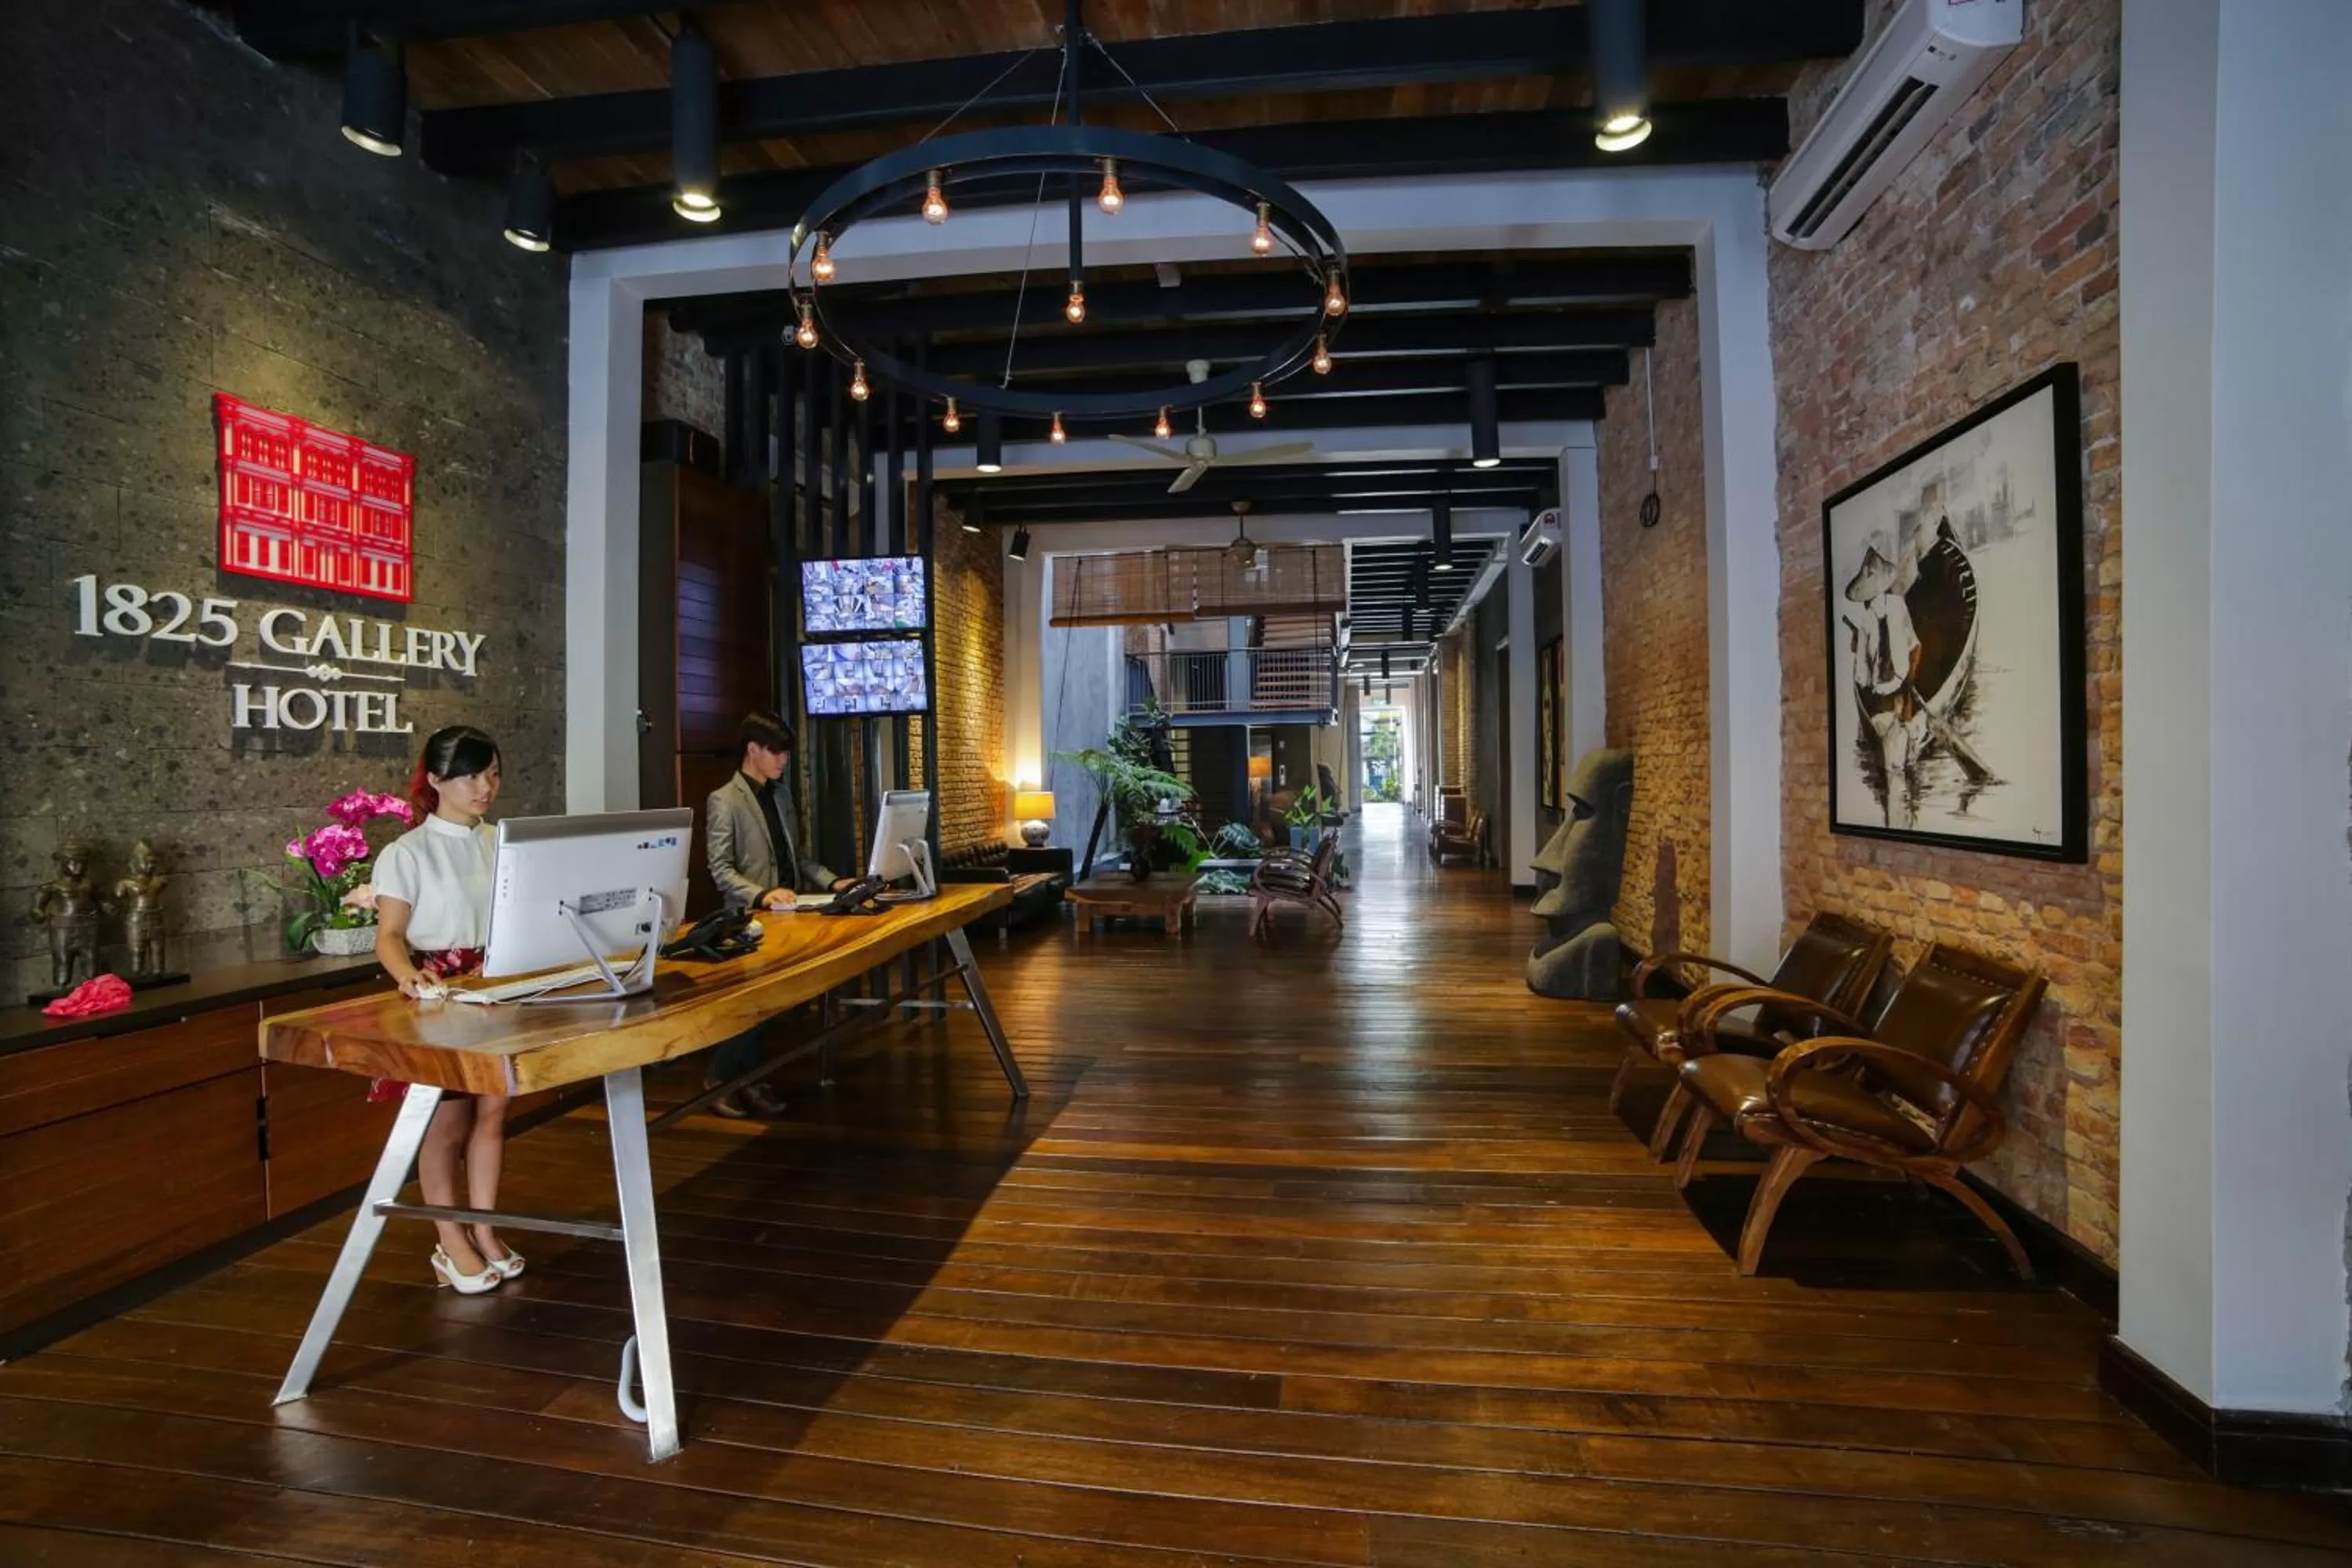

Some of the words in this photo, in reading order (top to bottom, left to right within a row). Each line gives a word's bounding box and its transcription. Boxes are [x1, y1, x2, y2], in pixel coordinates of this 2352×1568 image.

[74, 575, 238, 647] 1825
[259, 609, 485, 677] GALLERY
[232, 684, 414, 733] HOTEL
